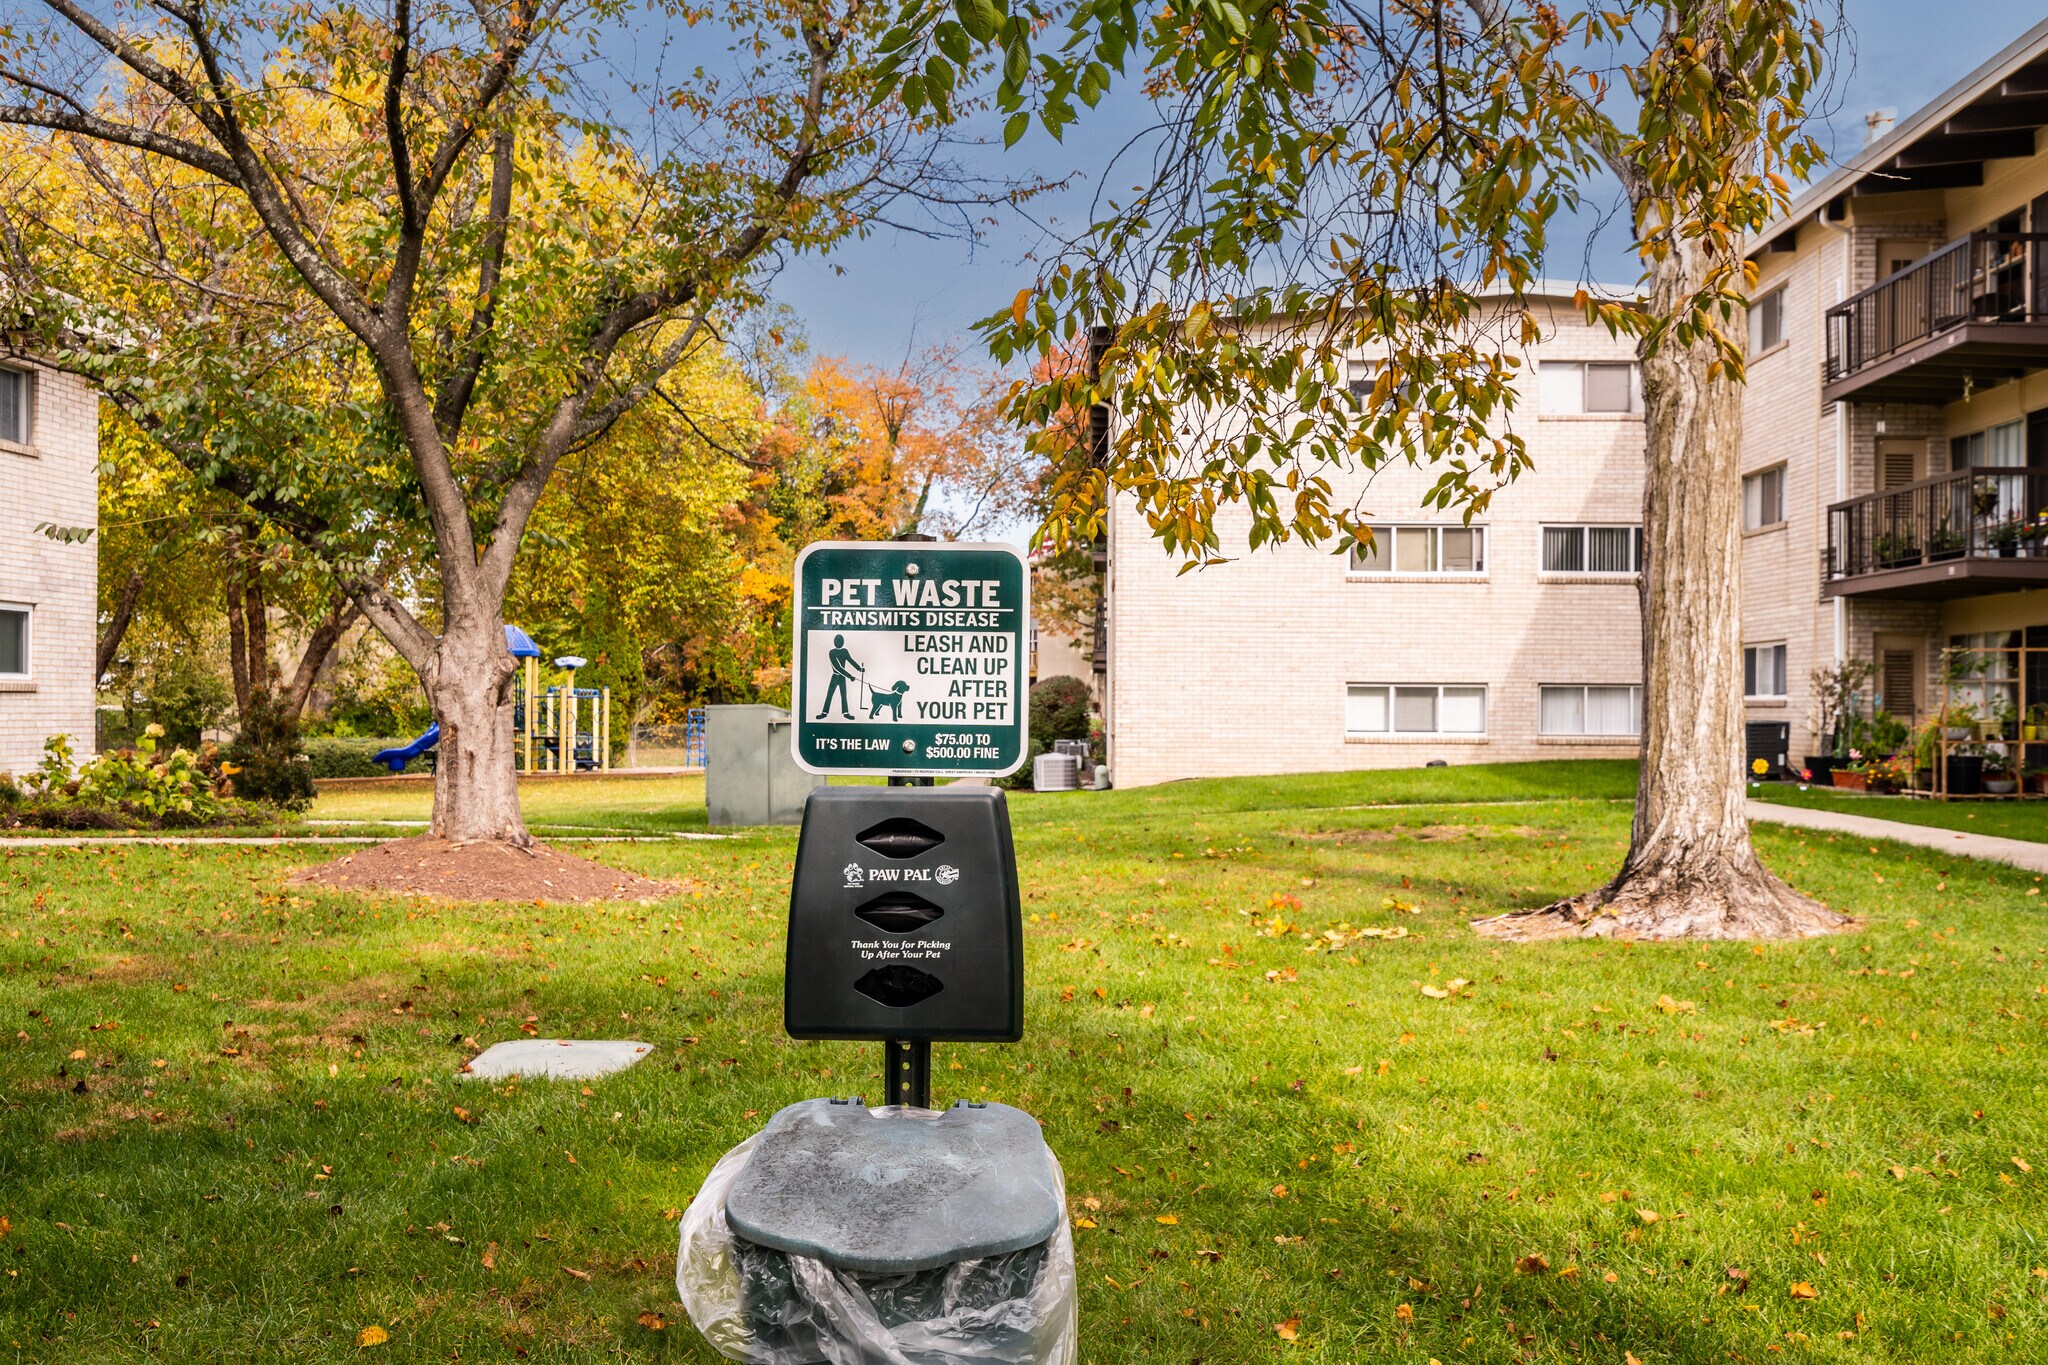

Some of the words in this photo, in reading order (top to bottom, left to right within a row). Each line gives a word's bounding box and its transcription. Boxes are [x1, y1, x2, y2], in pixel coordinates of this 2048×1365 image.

[821, 578, 882, 606] PET
[892, 579, 1001, 607] WASTE
[820, 610, 921, 626] TRANSMITS
[926, 612, 1000, 627] DISEASE
[903, 634, 964, 653] LEASH
[968, 635, 1008, 653] AND
[916, 656, 978, 675] CLEAN
[983, 657, 1008, 676] UP
[948, 679, 1008, 698] AFTER
[916, 701, 967, 720] YOUR
[973, 702, 1008, 720] PET
[815, 738, 838, 750] IT'S
[840, 738, 862, 750] THE
[864, 738, 891, 751] LAW
[934, 733, 974, 746] $75.00
[975, 733, 991, 746] TO
[926, 746, 971, 760] $500.00
[973, 747, 1000, 759] FINE
[868, 868, 901, 881] PAW
[903, 868, 932, 881] PAL
[851, 940, 880, 949] Thank
[881, 940, 899, 949] You
[900, 940, 915, 951] for
[917, 940, 951, 951] Picking
[861, 950, 875, 960] Up
[876, 950, 900, 960] After
[902, 950, 924, 959] Your
[925, 950, 941, 959] Pet
